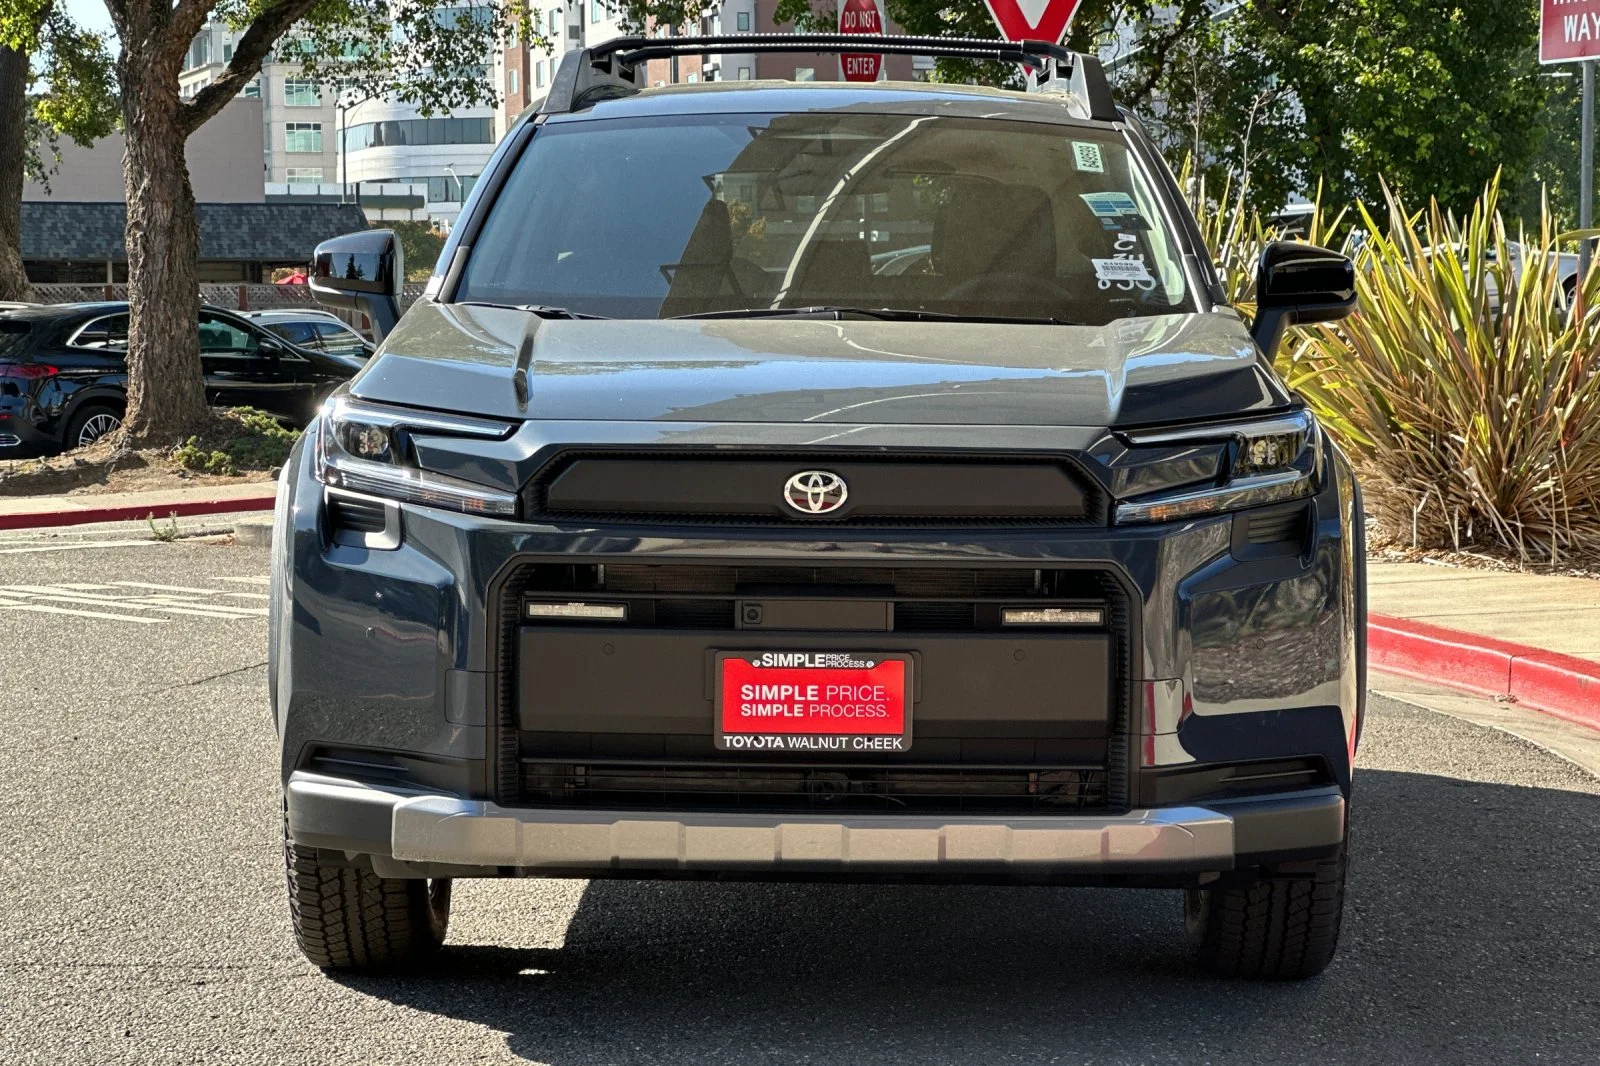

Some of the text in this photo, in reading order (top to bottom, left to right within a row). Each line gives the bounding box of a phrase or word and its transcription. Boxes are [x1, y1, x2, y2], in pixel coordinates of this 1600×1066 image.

[845, 11, 876, 28] DO NOT
[1564, 12, 1600, 43] WAY
[847, 58, 874, 74] ENTER
[762, 653, 826, 668] SIMPLE
[741, 685, 890, 701] SIMPLE PRICE.
[741, 704, 890, 718] SIMPLE PROCESS.
[723, 736, 785, 748] TOYOTA
[787, 736, 850, 749] WALNUT
